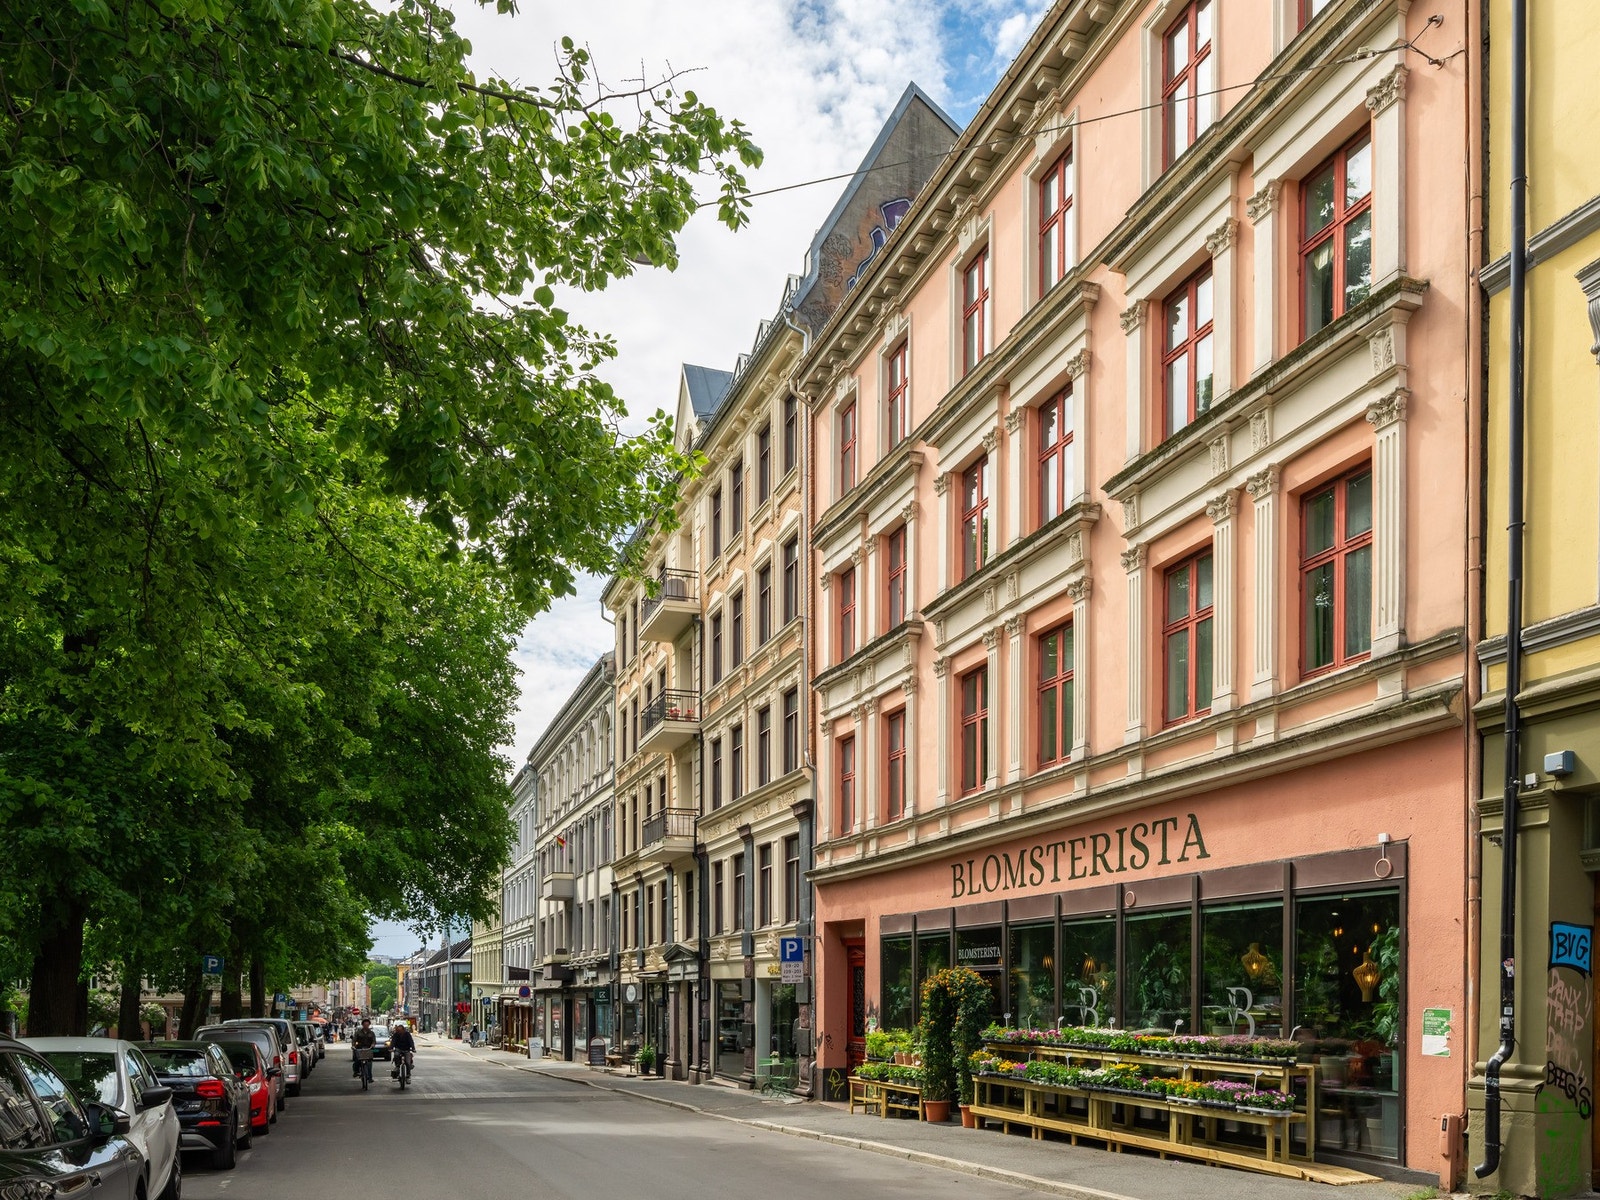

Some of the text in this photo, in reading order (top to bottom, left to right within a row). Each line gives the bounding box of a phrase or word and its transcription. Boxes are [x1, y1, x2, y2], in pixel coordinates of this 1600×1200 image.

[951, 813, 1211, 898] BLOMSTERISTA
[786, 941, 798, 959] P
[958, 946, 1002, 960] BLOMSTERISTA
[207, 958, 218, 971] P
